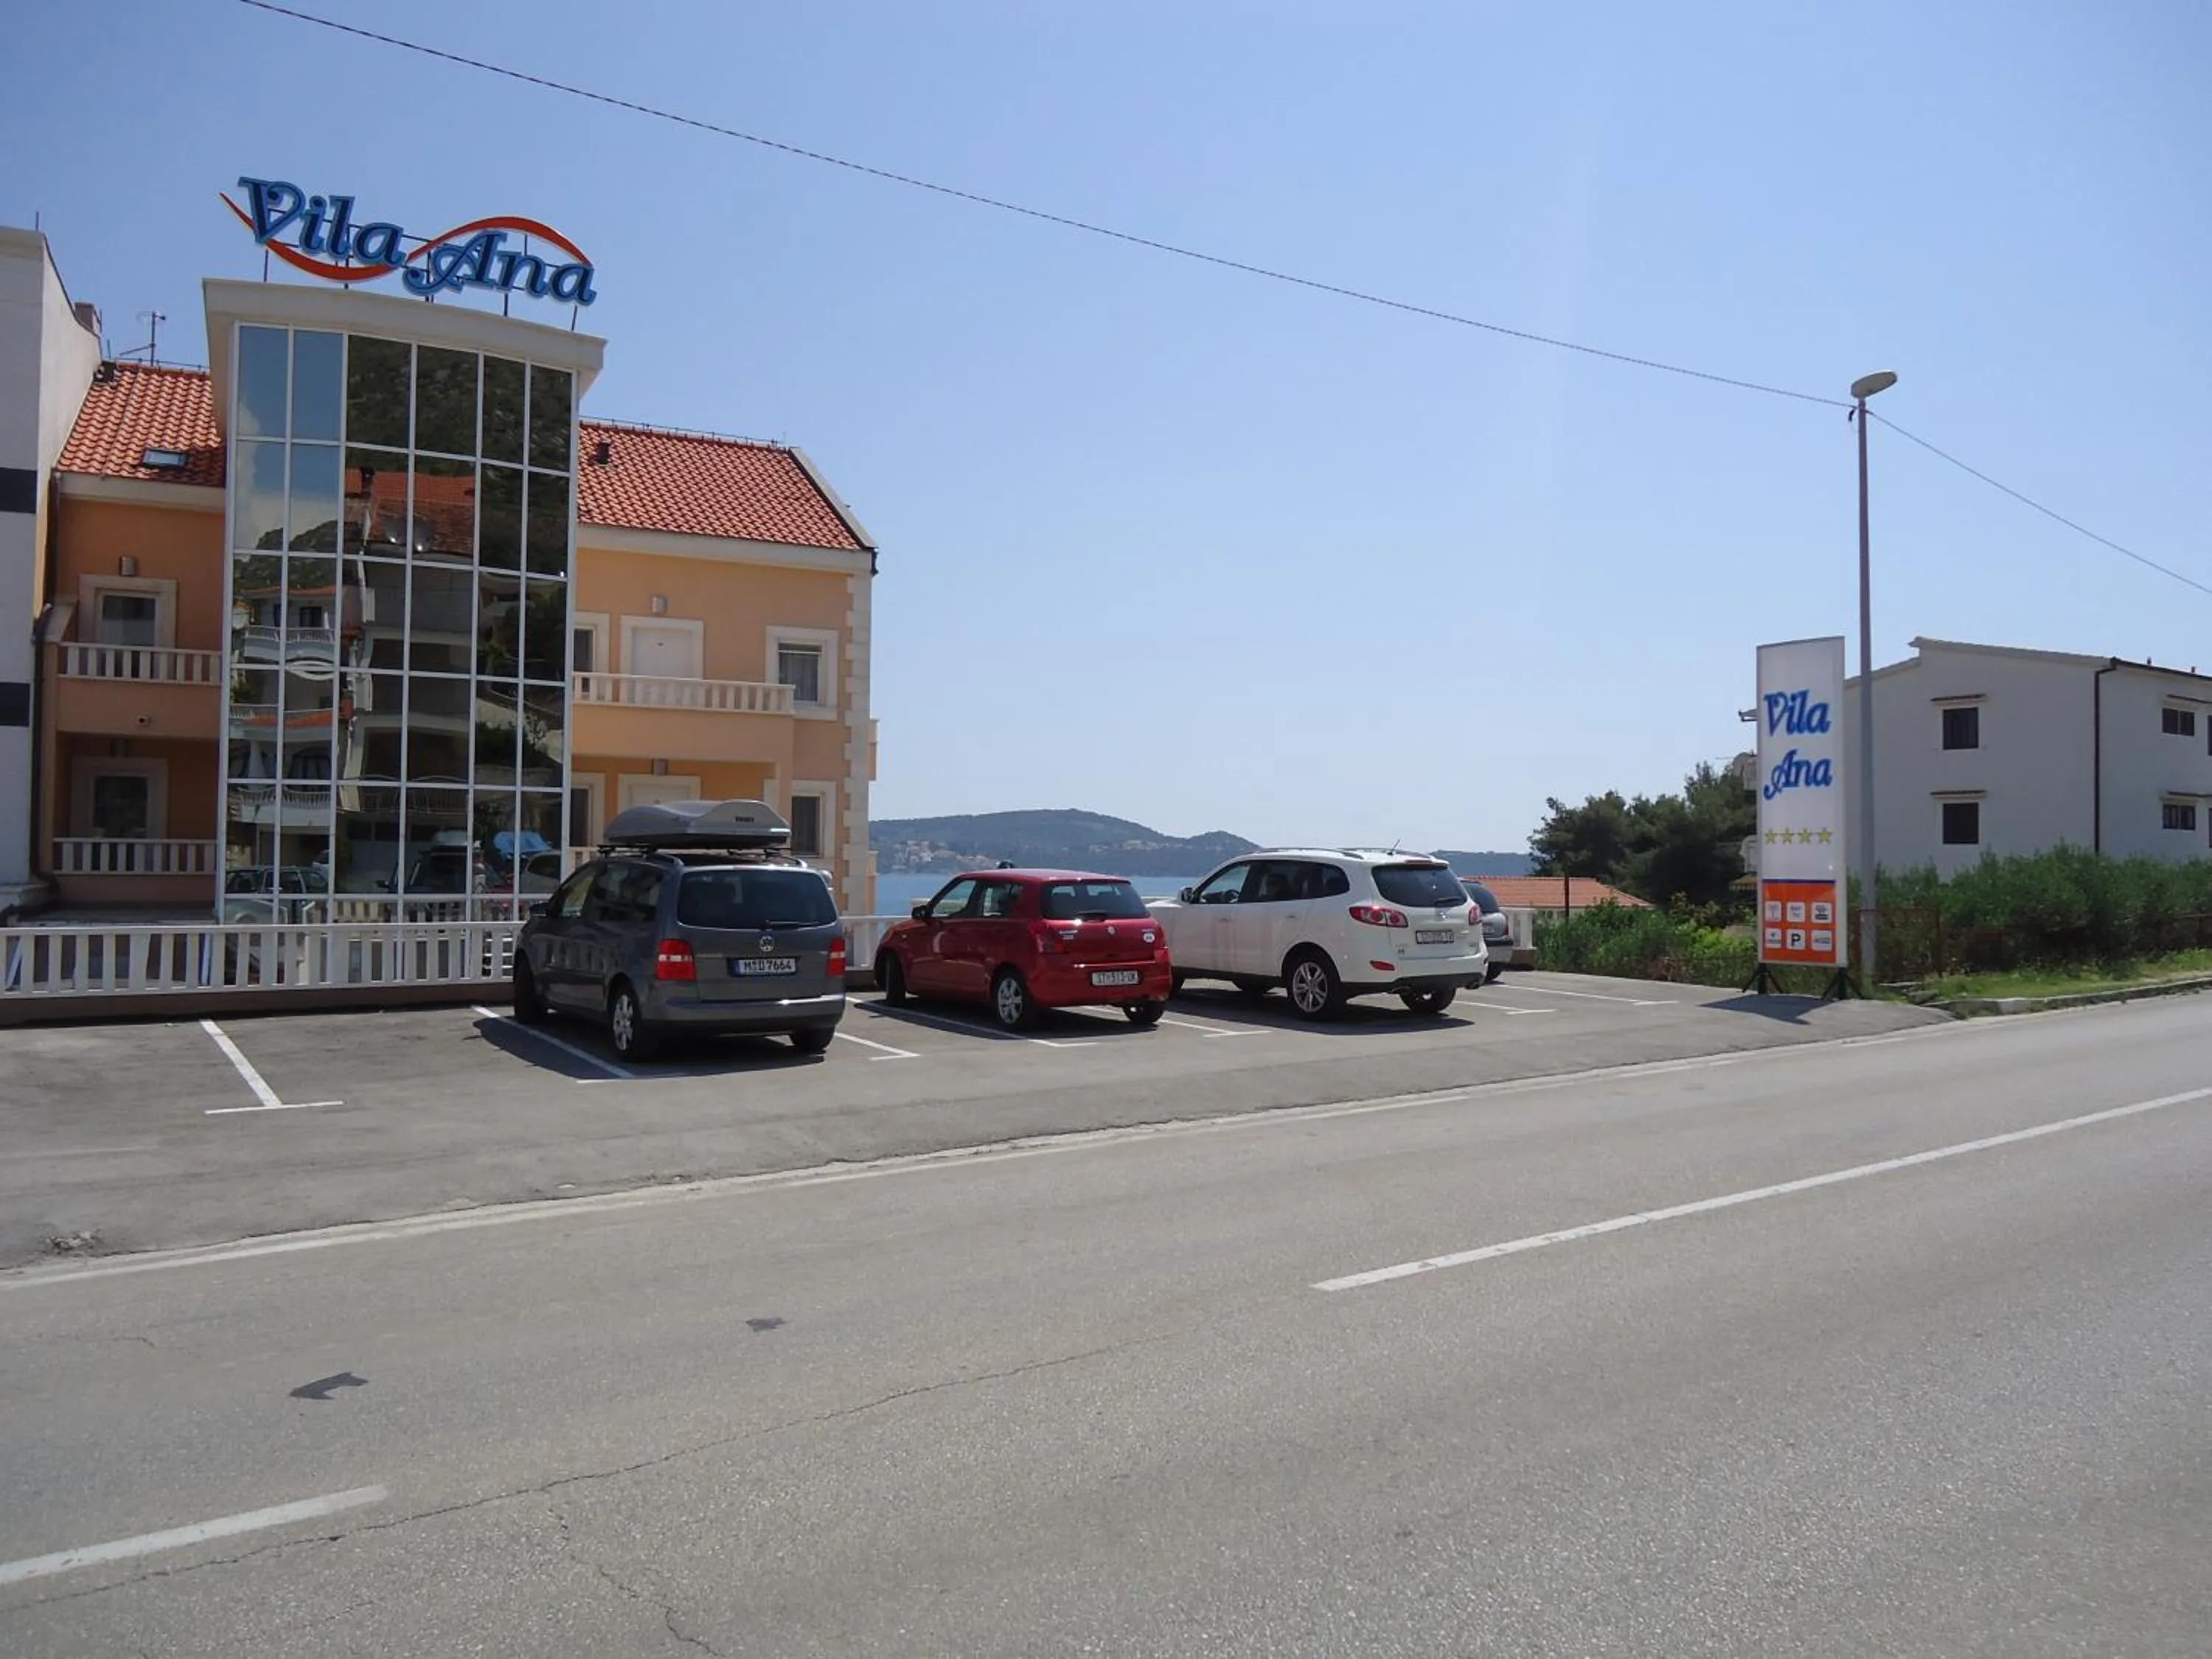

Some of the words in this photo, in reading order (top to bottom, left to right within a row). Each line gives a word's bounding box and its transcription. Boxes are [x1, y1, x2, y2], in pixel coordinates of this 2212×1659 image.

[237, 176, 406, 268] Vila
[402, 229, 597, 306] Ana
[1763, 688, 1832, 737] Vila
[1763, 748, 1833, 801] Ana
[1791, 933, 1801, 947] P
